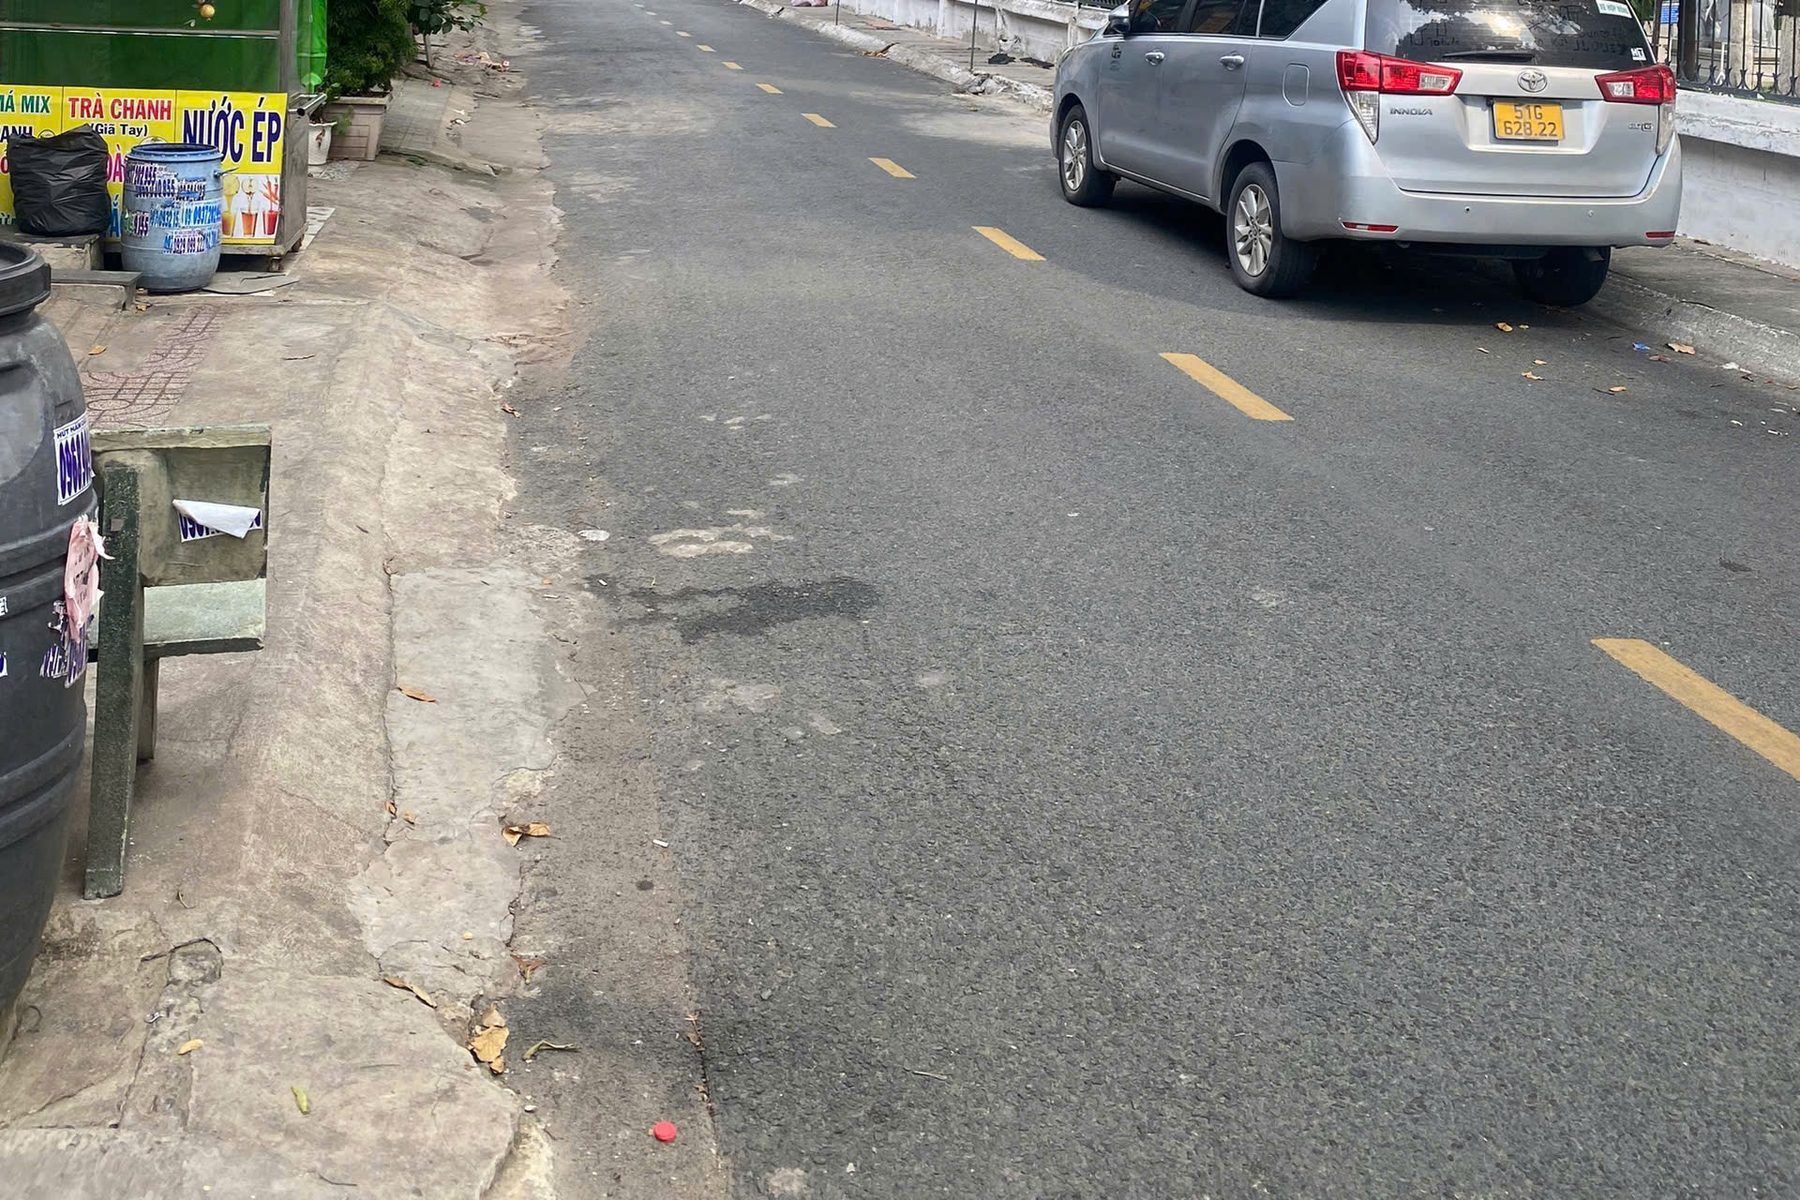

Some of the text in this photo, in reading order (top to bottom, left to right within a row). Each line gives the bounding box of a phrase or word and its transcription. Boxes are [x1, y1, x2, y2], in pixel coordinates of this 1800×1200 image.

[21, 95, 51, 113] MIX
[68, 92, 172, 120] TRÀ CHANH
[1390, 108, 1433, 116] INNOVA
[1513, 104, 1543, 120] 51G
[120, 123, 148, 137] Tay)
[183, 96, 245, 163] NƯỚC
[251, 97, 281, 163] ÉP
[1503, 120, 1558, 137] 628.22
